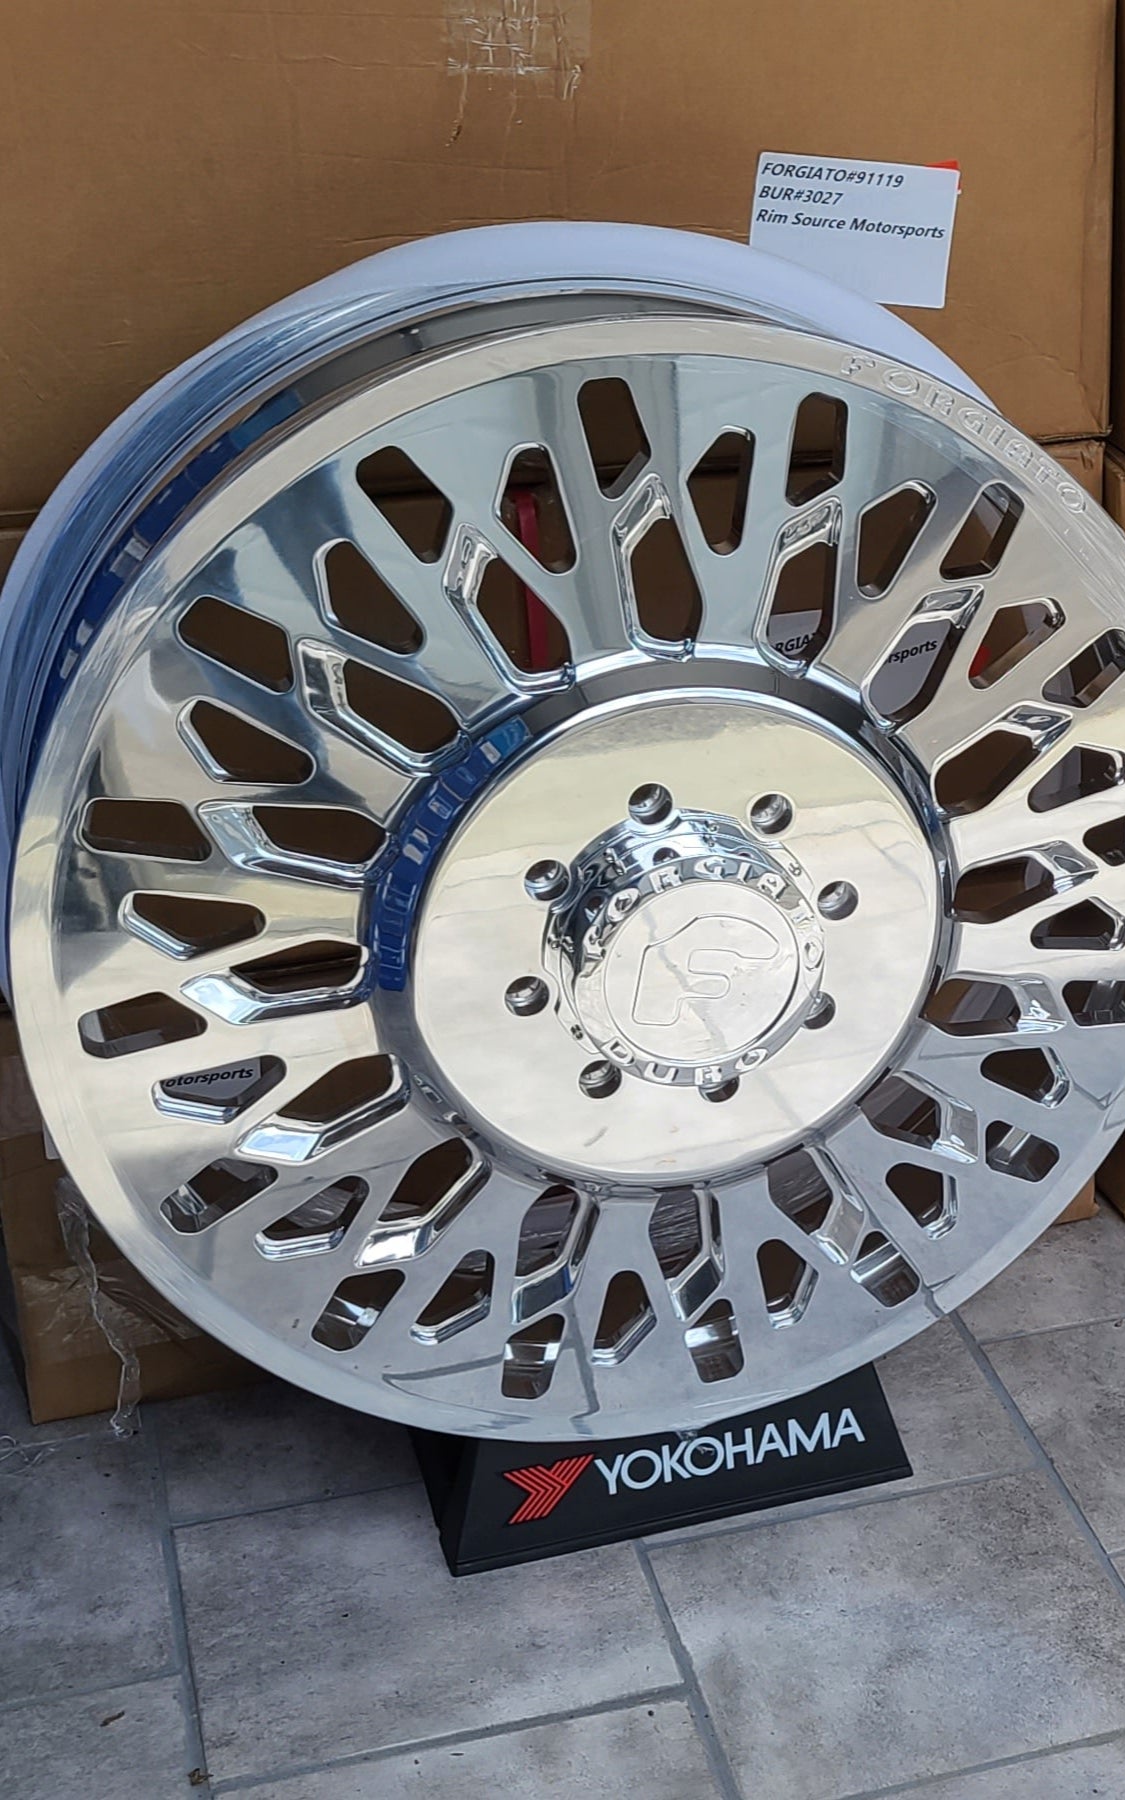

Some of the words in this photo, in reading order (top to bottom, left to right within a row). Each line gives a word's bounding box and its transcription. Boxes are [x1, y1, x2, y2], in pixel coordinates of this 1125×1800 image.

[761, 162, 904, 188] FORGIATO#91119
[758, 185, 843, 205] BUR#3027
[756, 209, 788, 225] Rim
[791, 212, 846, 229] Source
[849, 218, 945, 240] Motorsports
[840, 354, 1087, 513] FORGIATO
[594, 1407, 866, 1496] YOKOHAMA
